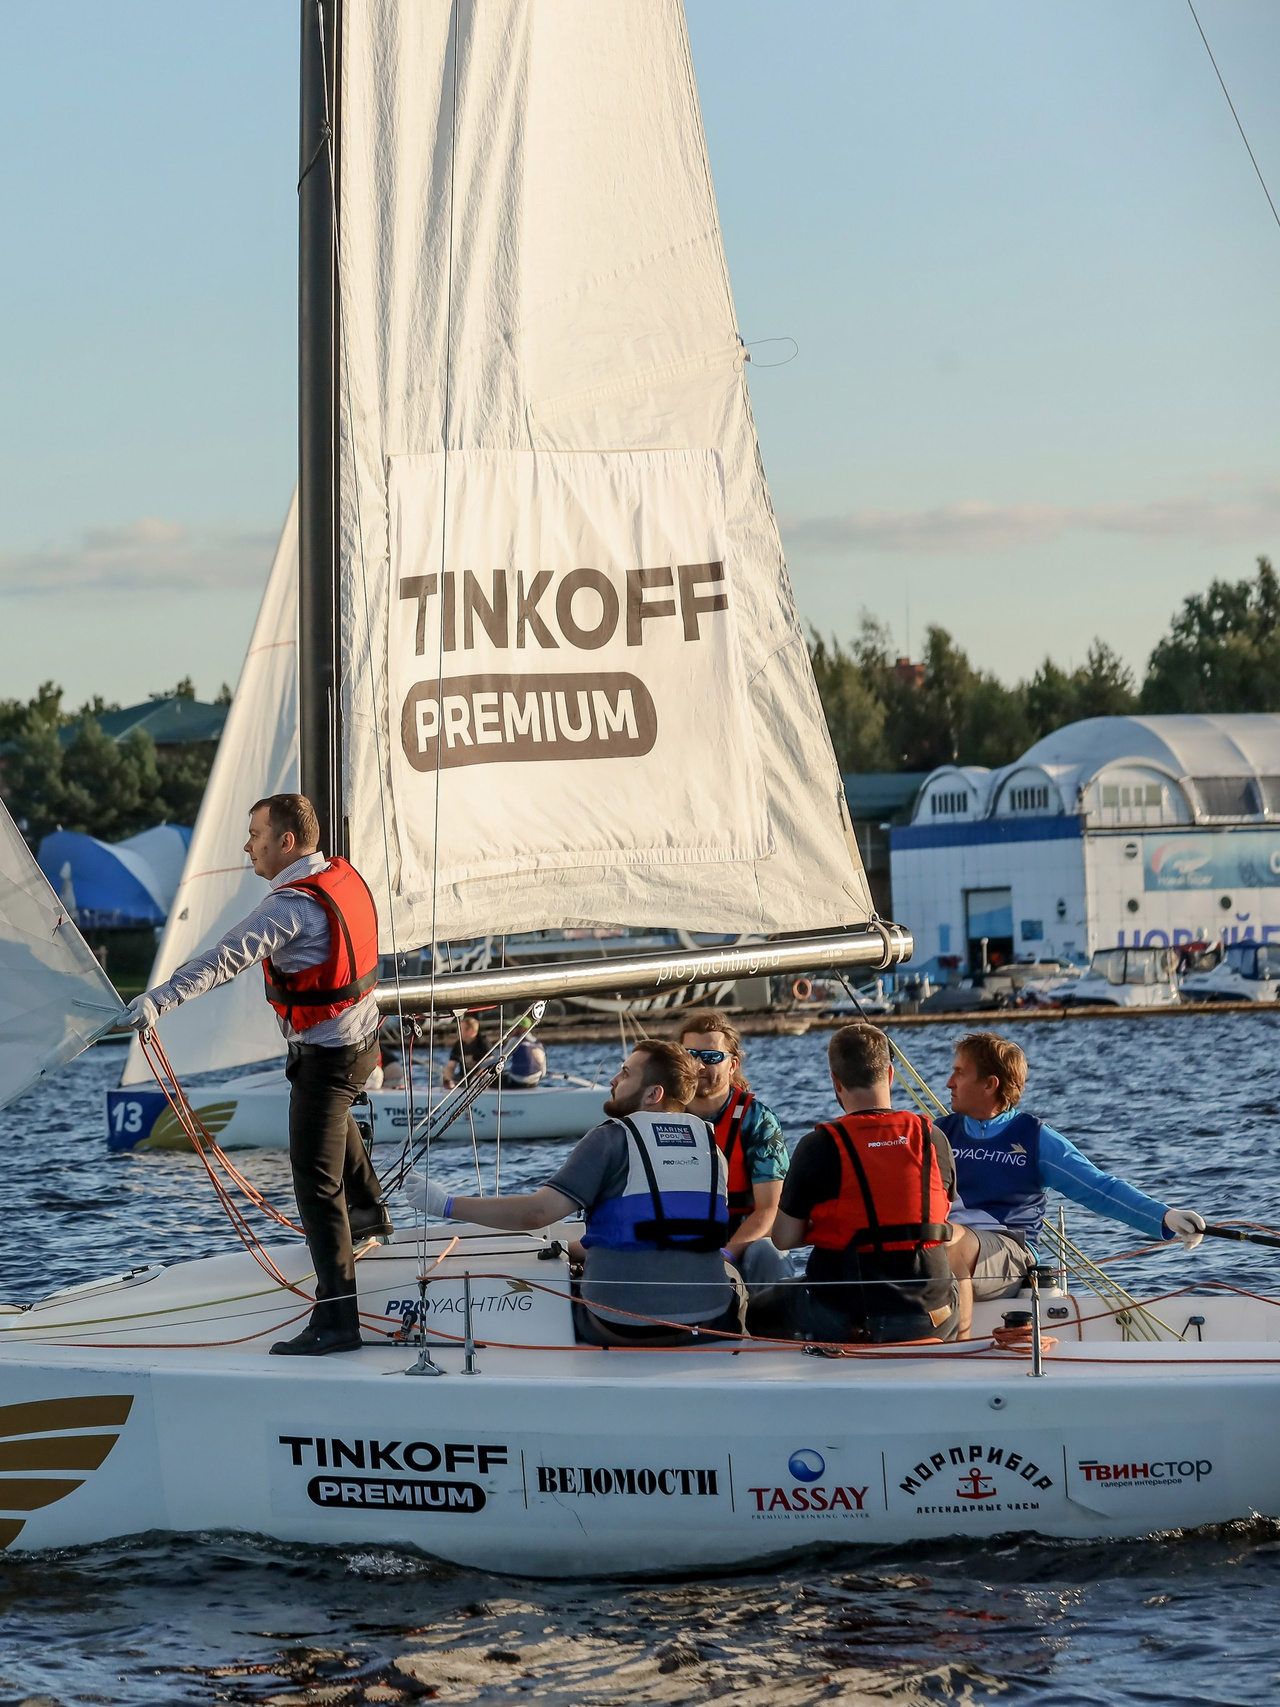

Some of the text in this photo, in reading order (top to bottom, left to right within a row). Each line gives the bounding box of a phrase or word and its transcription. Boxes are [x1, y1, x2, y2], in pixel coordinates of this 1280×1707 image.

[399, 561, 729, 656] TINKOFF
[415, 689, 639, 753] PREMIUM
[112, 1101, 143, 1132] 13
[655, 1125, 689, 1133] MARINE
[867, 1138, 908, 1148] PROYACHTING
[278, 1435, 508, 1474] TINKOFF
[536, 1466, 720, 1498] ВЕДОМОСТИ
[899, 1445, 1054, 1496] МОРПРИБОР
[1100, 1478, 1183, 1488] галерея интерьеров
[318, 1481, 474, 1507] PREMIUM
[747, 1486, 870, 1511] TASSAY
[916, 1502, 1040, 1514] ЛЕГЕНДАРНЫЕ ЧАСЫ
